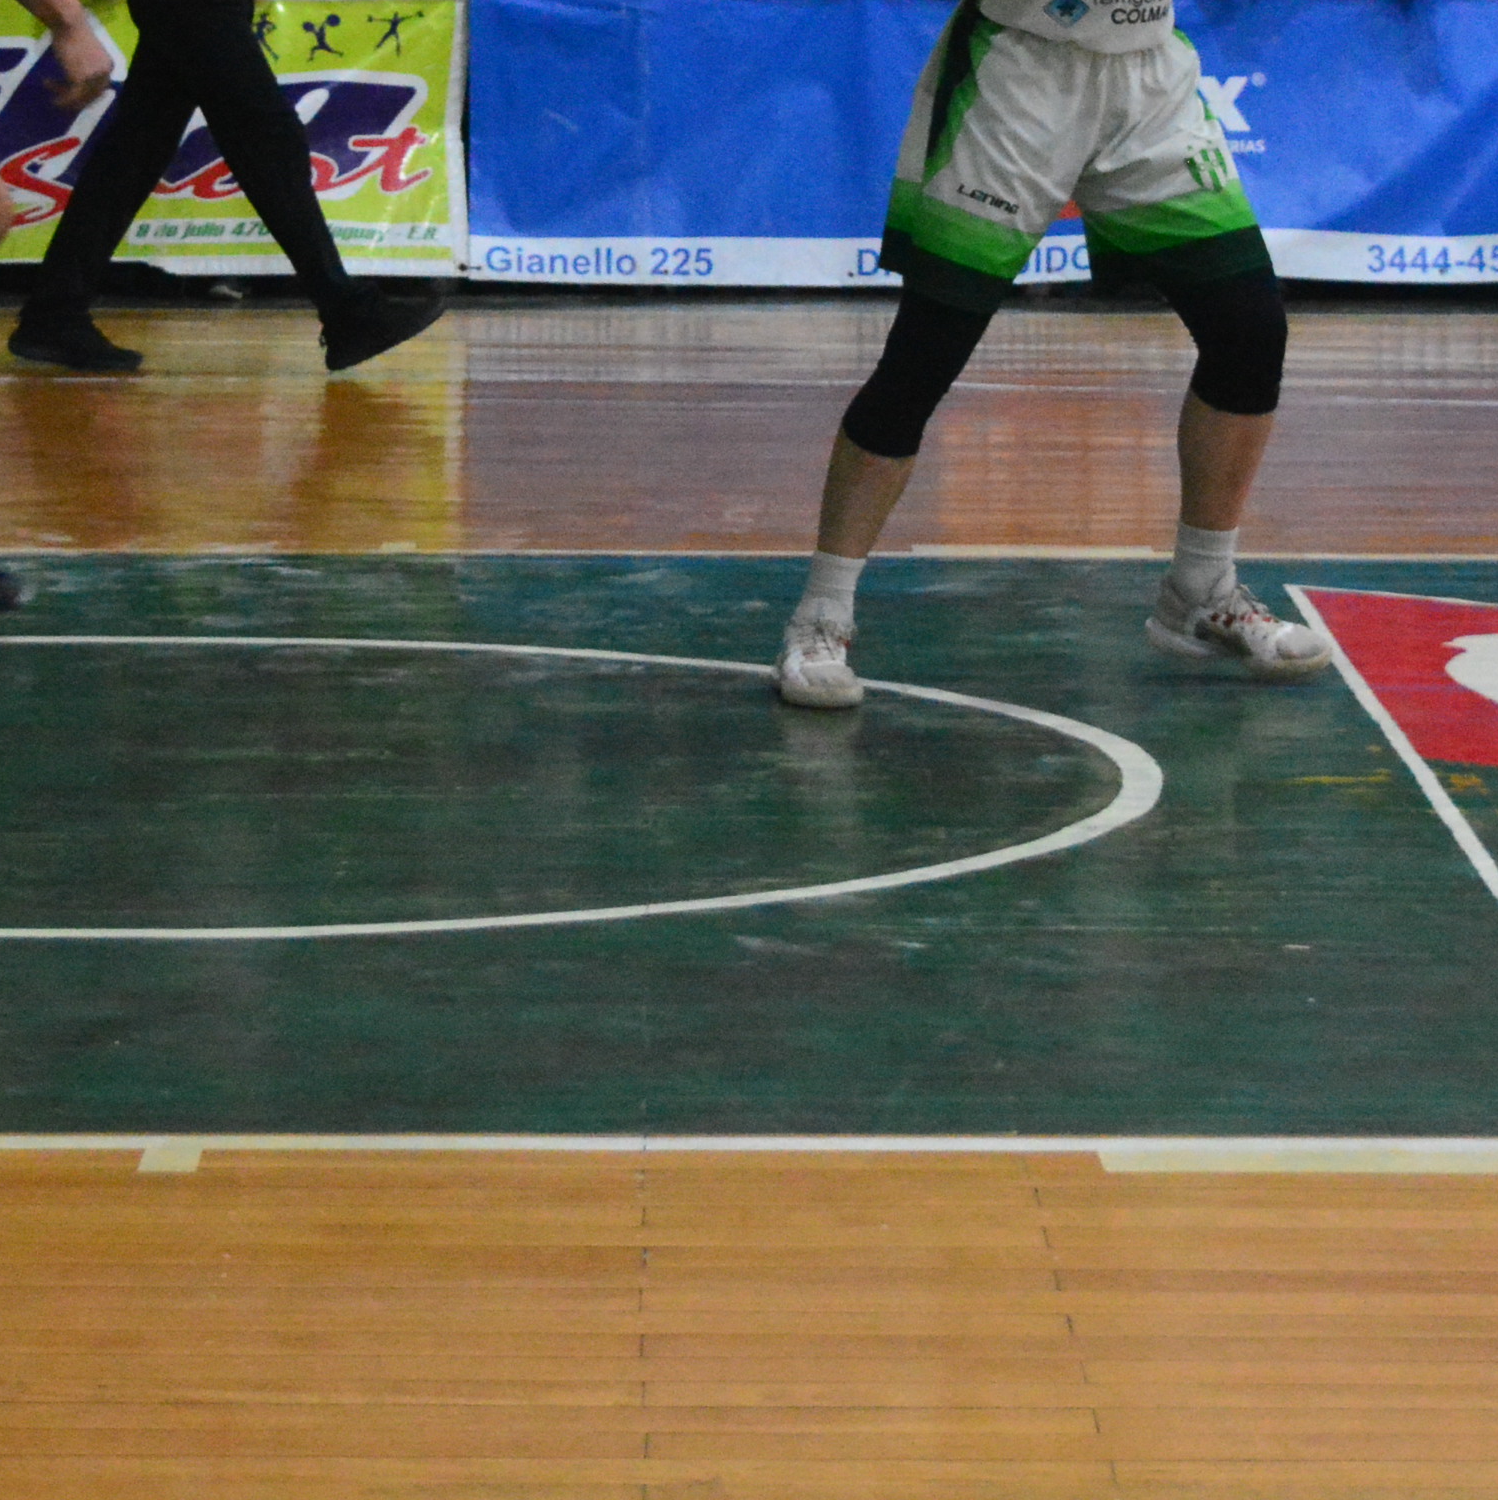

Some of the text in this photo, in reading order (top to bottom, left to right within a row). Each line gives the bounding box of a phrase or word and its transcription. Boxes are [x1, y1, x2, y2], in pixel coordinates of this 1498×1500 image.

[180, 222, 225, 240] julio
[485, 245, 714, 277] Gianello 225
